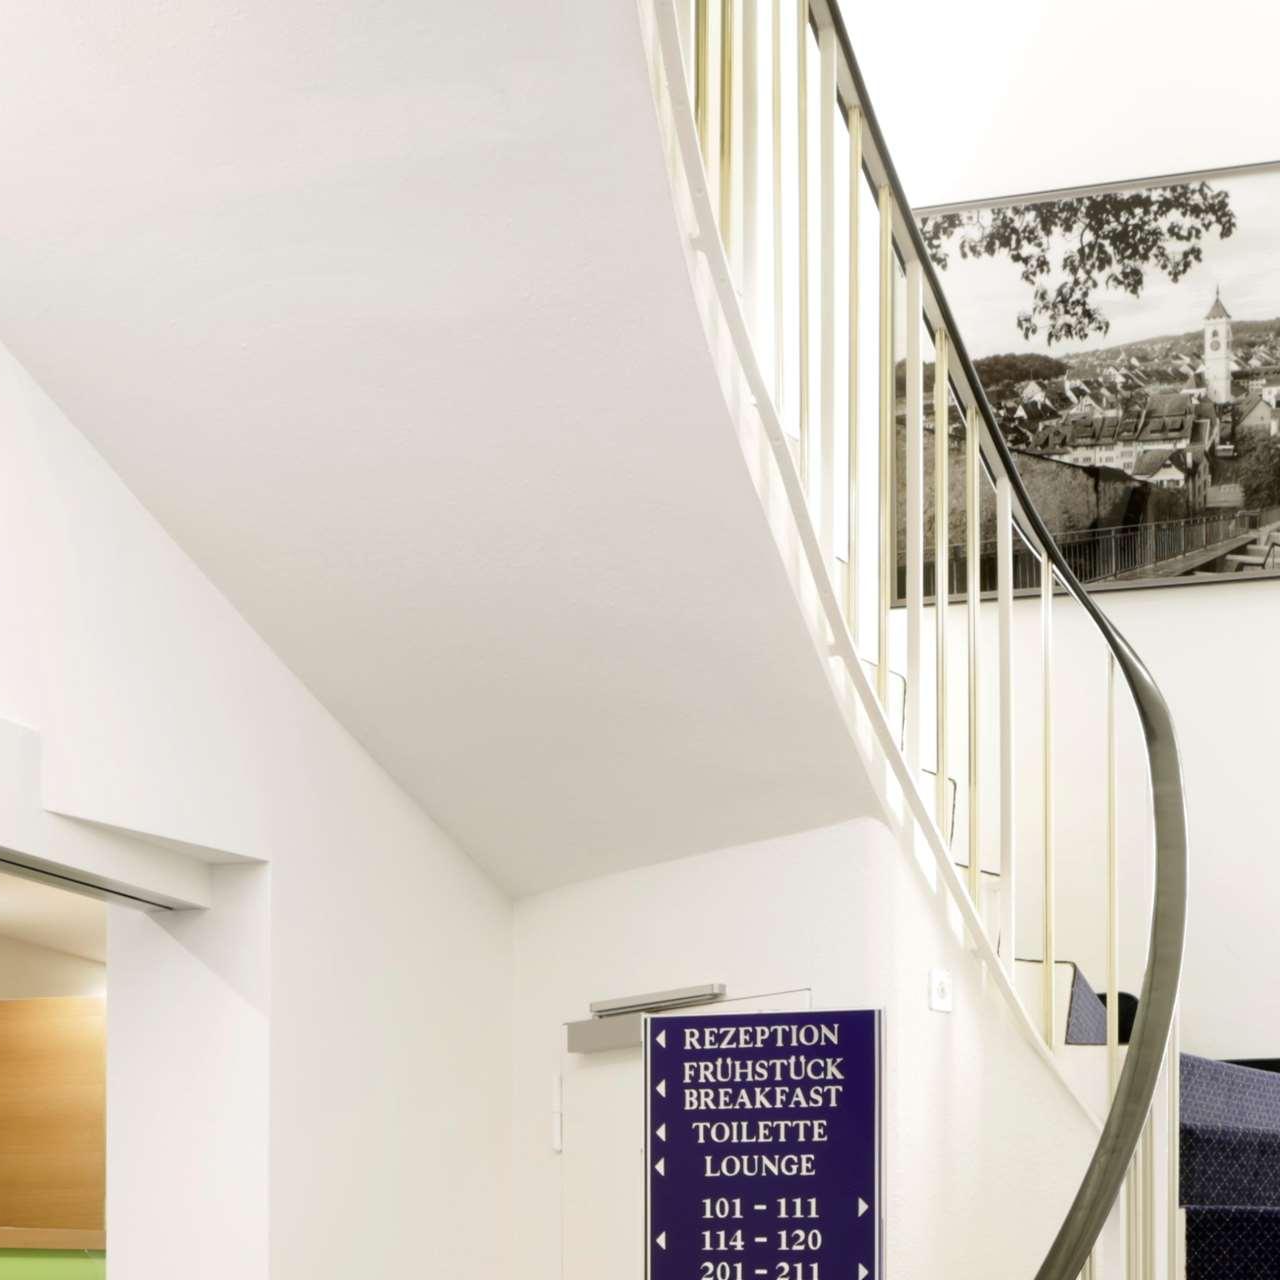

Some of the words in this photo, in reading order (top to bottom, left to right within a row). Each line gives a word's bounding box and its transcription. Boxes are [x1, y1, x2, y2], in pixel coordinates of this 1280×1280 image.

[683, 1023, 839, 1050] REZEPTION
[682, 1056, 845, 1084] FRÜHSTÜCK
[683, 1085, 843, 1111] BREAKFAST
[691, 1119, 828, 1144] TOILETTE
[704, 1153, 816, 1177] LOUNGE
[701, 1197, 744, 1219] 101
[776, 1197, 820, 1219] 111
[700, 1229, 745, 1251] 114
[777, 1229, 822, 1251] 120
